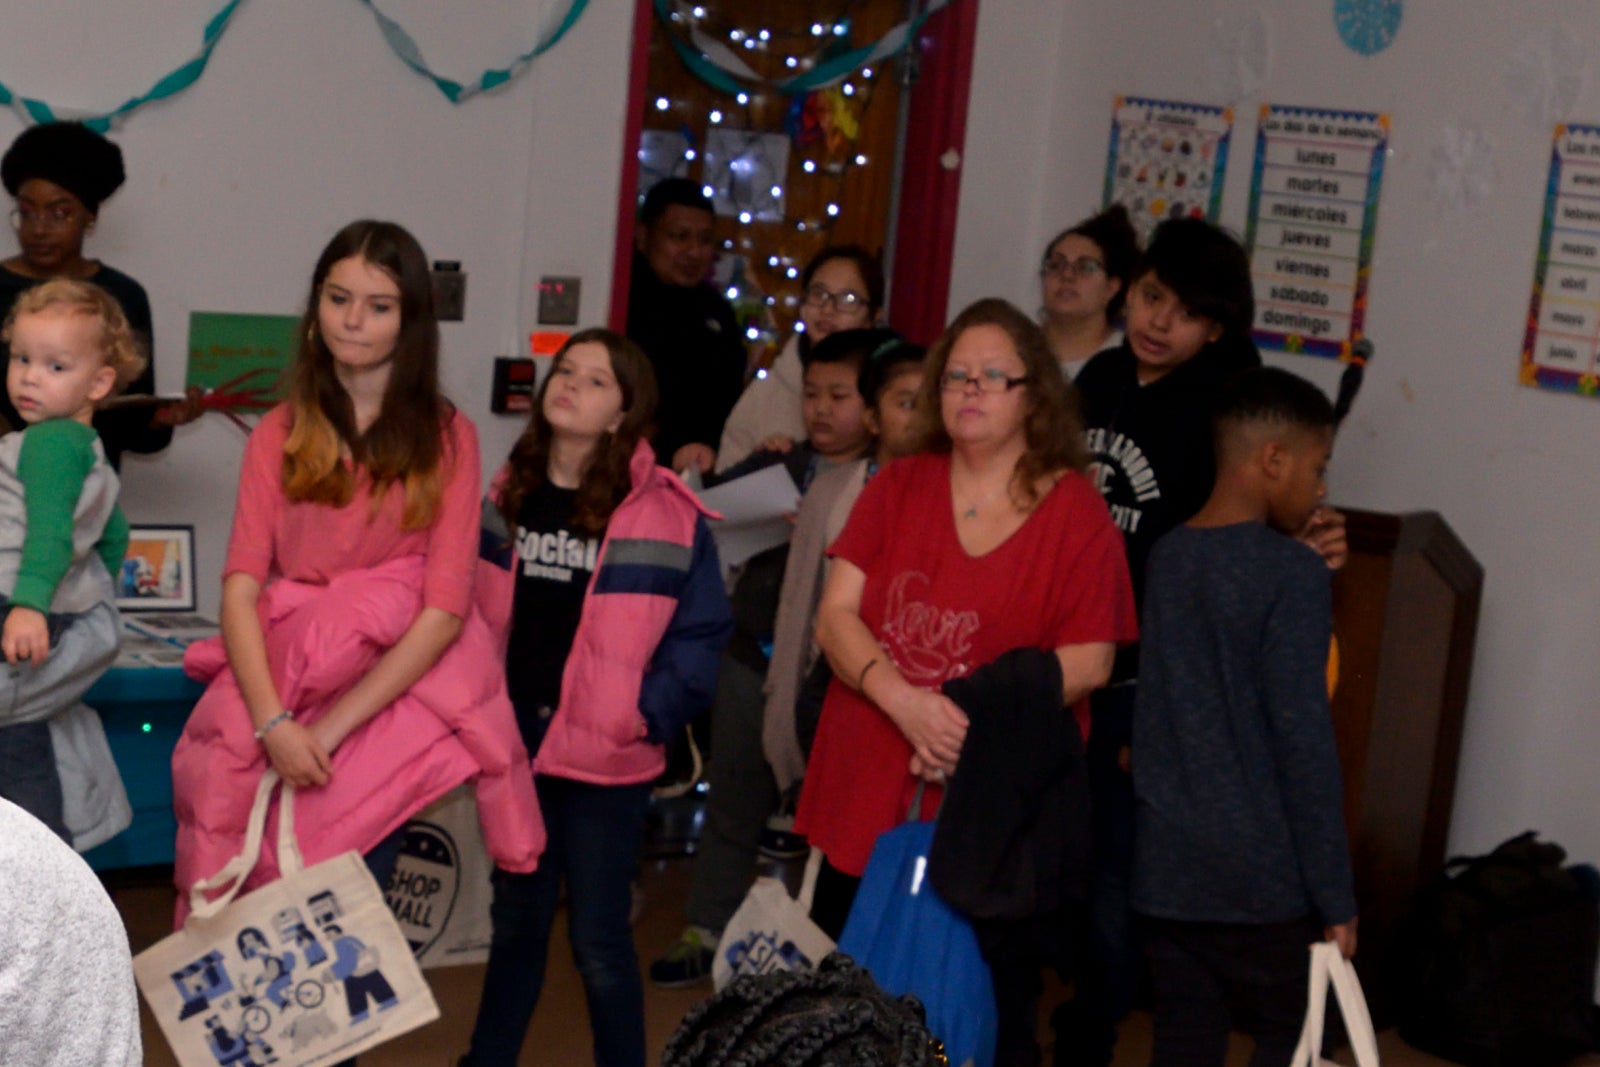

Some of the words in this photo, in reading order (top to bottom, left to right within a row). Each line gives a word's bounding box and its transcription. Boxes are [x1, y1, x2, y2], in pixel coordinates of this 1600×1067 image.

[1297, 148, 1336, 166] lunes
[1286, 174, 1339, 194] martes
[1280, 228, 1332, 249] jueves
[1275, 257, 1331, 279] viernes
[1262, 308, 1332, 336] domingo
[515, 526, 598, 572] Social
